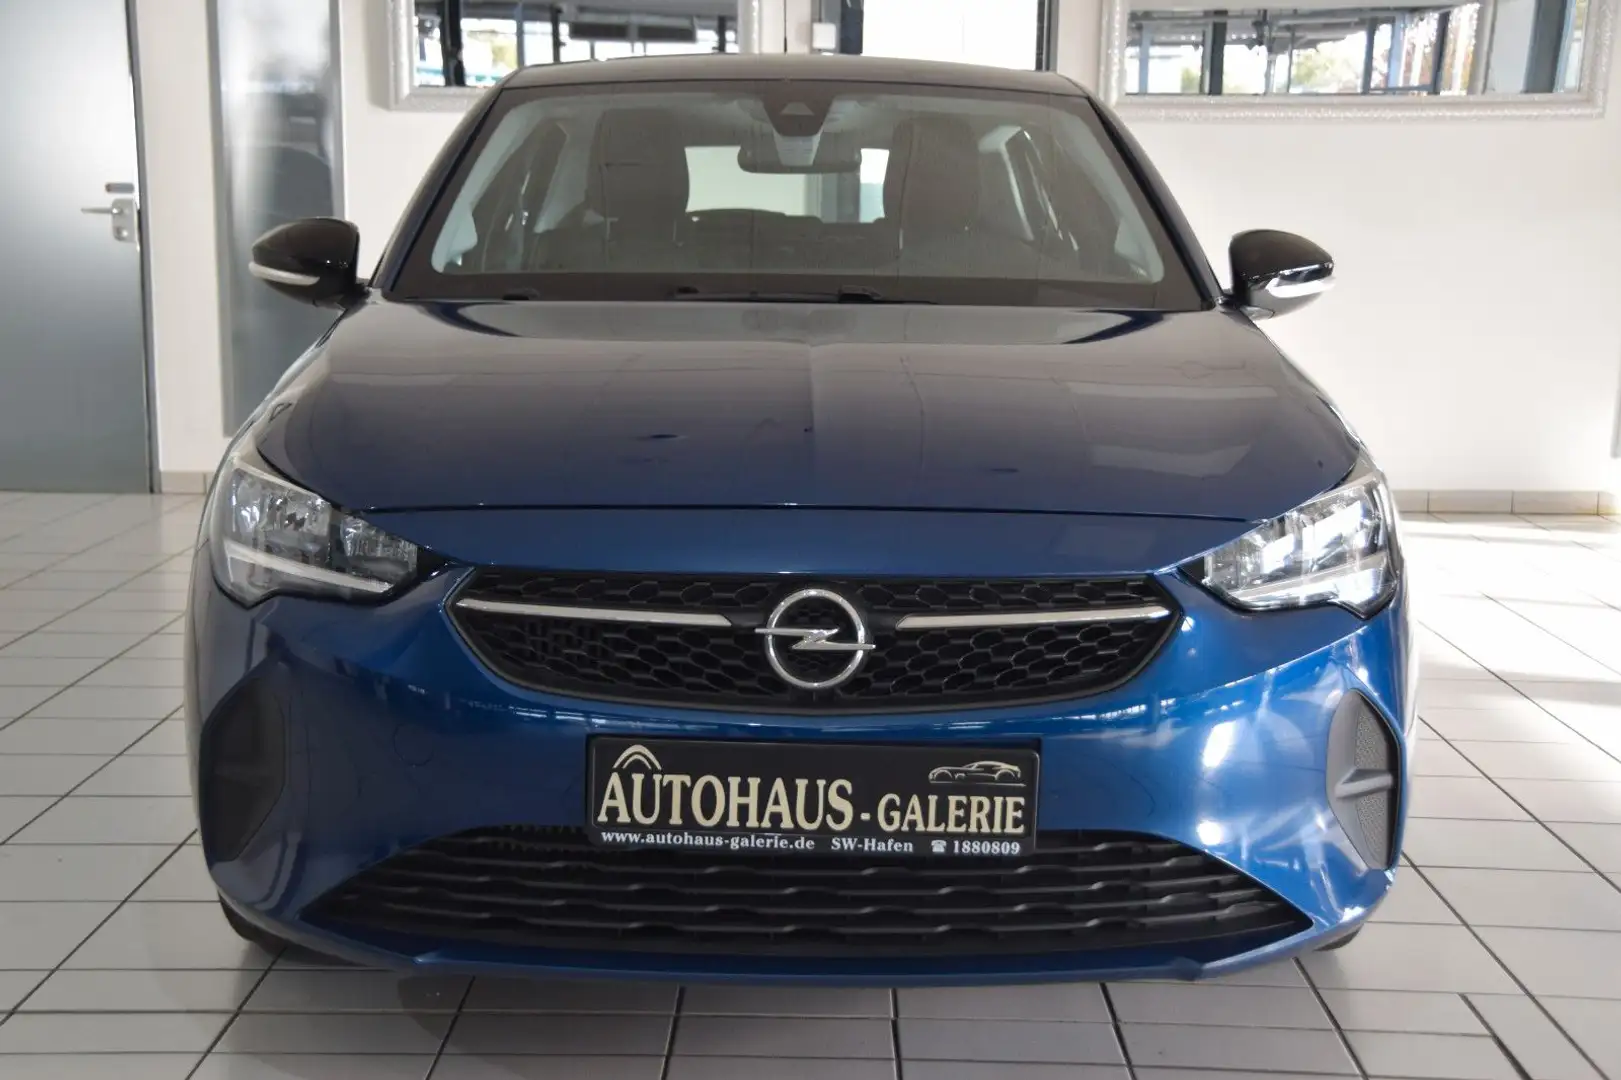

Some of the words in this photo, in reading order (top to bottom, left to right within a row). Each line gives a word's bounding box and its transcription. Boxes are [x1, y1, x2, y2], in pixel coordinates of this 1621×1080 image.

[598, 772, 853, 831] AUTOHAUS
[601, 831, 815, 850] www.autohaus-galerie.de
[831, 838, 914, 853] SW-Hafen
[953, 840, 1020, 855] 1880809
